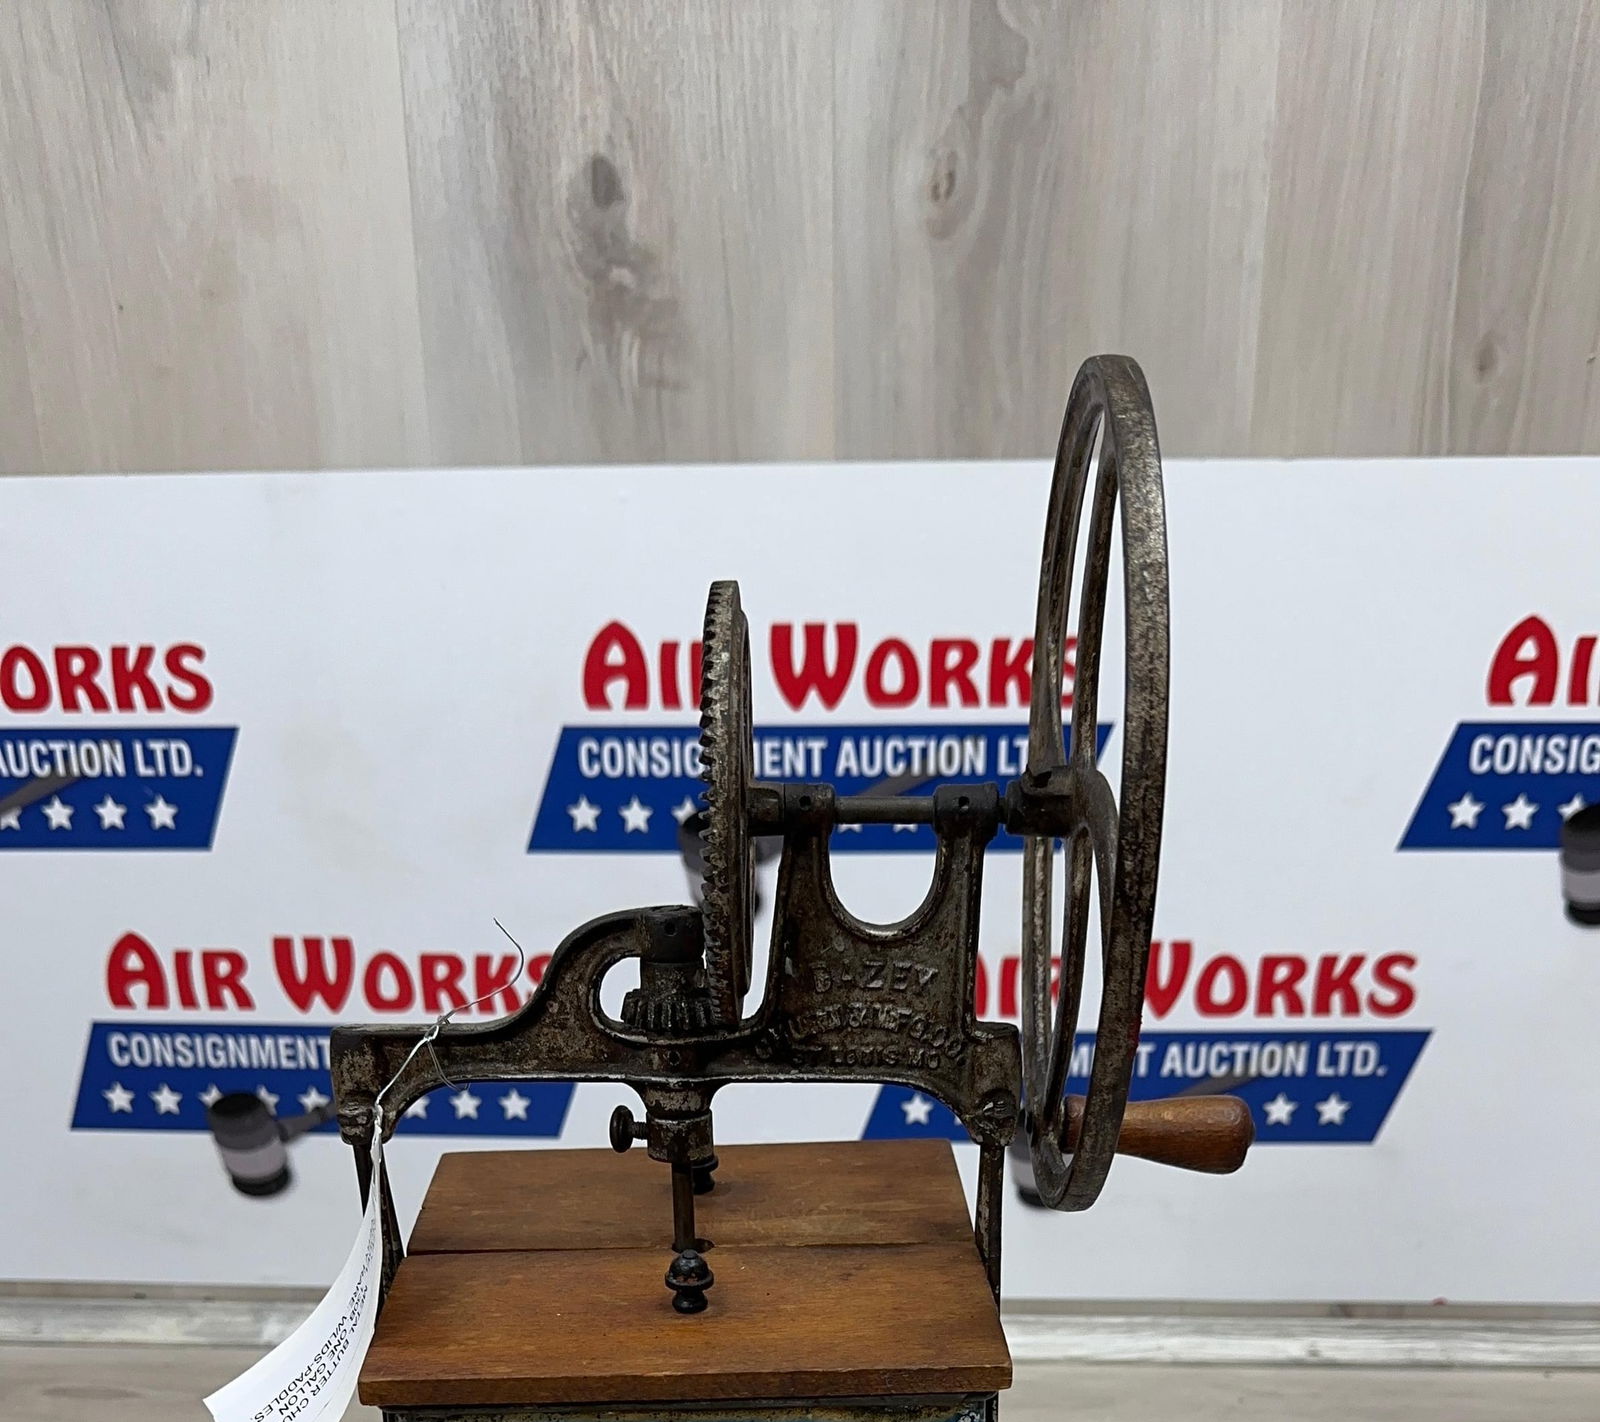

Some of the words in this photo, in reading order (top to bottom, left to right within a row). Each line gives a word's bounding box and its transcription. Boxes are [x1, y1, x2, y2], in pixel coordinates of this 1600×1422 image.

[0, 644, 213, 714] ORKS
[1486, 614, 1600, 706] AI
[132, 739, 203, 777] LTD.
[578, 736, 827, 779] CONSIGENT
[835, 736, 986, 778] AUCTION
[1468, 734, 1600, 775] CONSIG
[106, 930, 256, 1011] AIR
[107, 1031, 331, 1071] CONSIGNMENT
[1159, 1041, 1307, 1079] AUCTION
[1315, 1041, 1388, 1078] LTD.
[312, 1338, 350, 1398] BUTTER
[326, 1332, 351, 1361] ONE
[280, 1361, 328, 1416] GALLON
